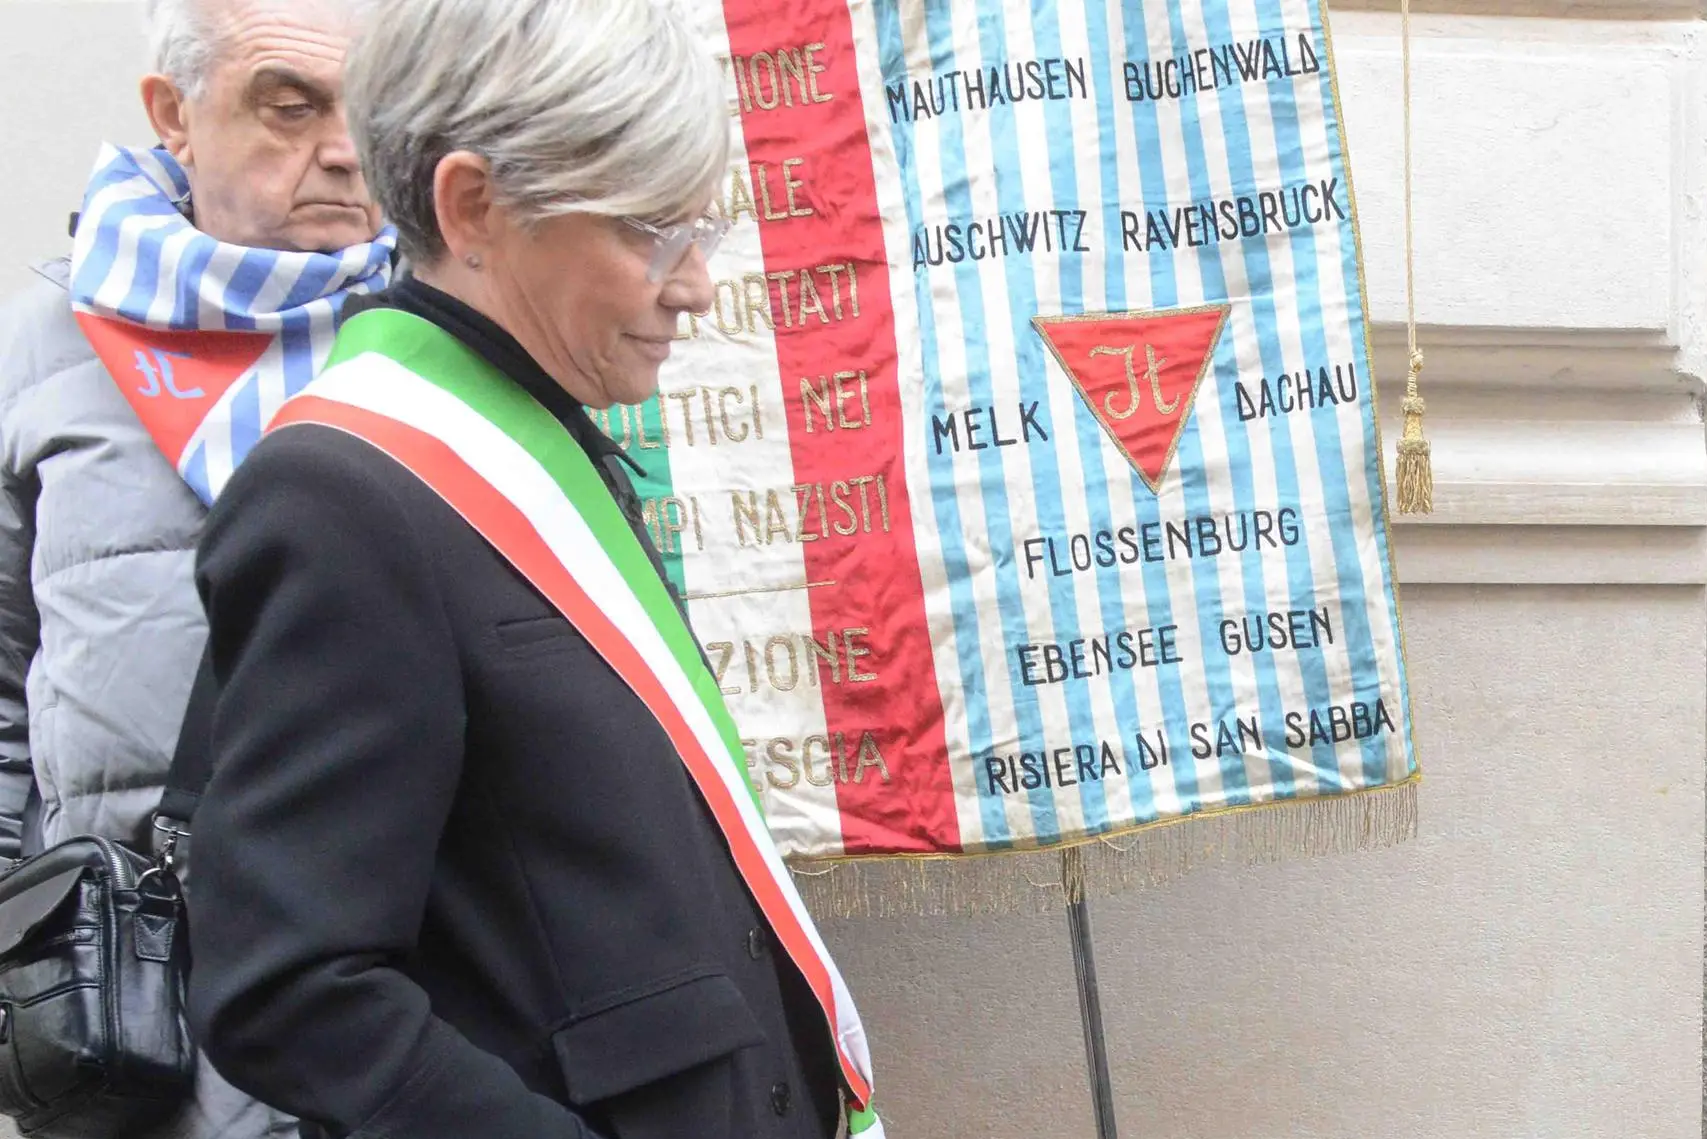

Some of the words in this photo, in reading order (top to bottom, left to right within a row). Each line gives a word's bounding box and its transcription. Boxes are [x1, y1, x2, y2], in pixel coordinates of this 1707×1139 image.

[885, 57, 1088, 124] MAUTHAUSEN
[1123, 33, 1321, 102] BUCHENWALD
[912, 209, 1091, 272] AUSCHWITZ
[1120, 177, 1346, 252] RAVENSBRUCK
[801, 370, 872, 433] NEI
[932, 400, 1049, 454] MELK
[1234, 362, 1357, 422] DACHAU
[732, 474, 891, 546] NAZISTI
[1023, 507, 1300, 580] FLOSSENBURG
[1017, 624, 1183, 686] EBENSEE
[1219, 606, 1334, 656] GUSEN
[985, 740, 1122, 795] RISIERA
[1135, 729, 1169, 770] DI
[1190, 716, 1262, 760] SAN
[1284, 697, 1396, 749] SABBA
